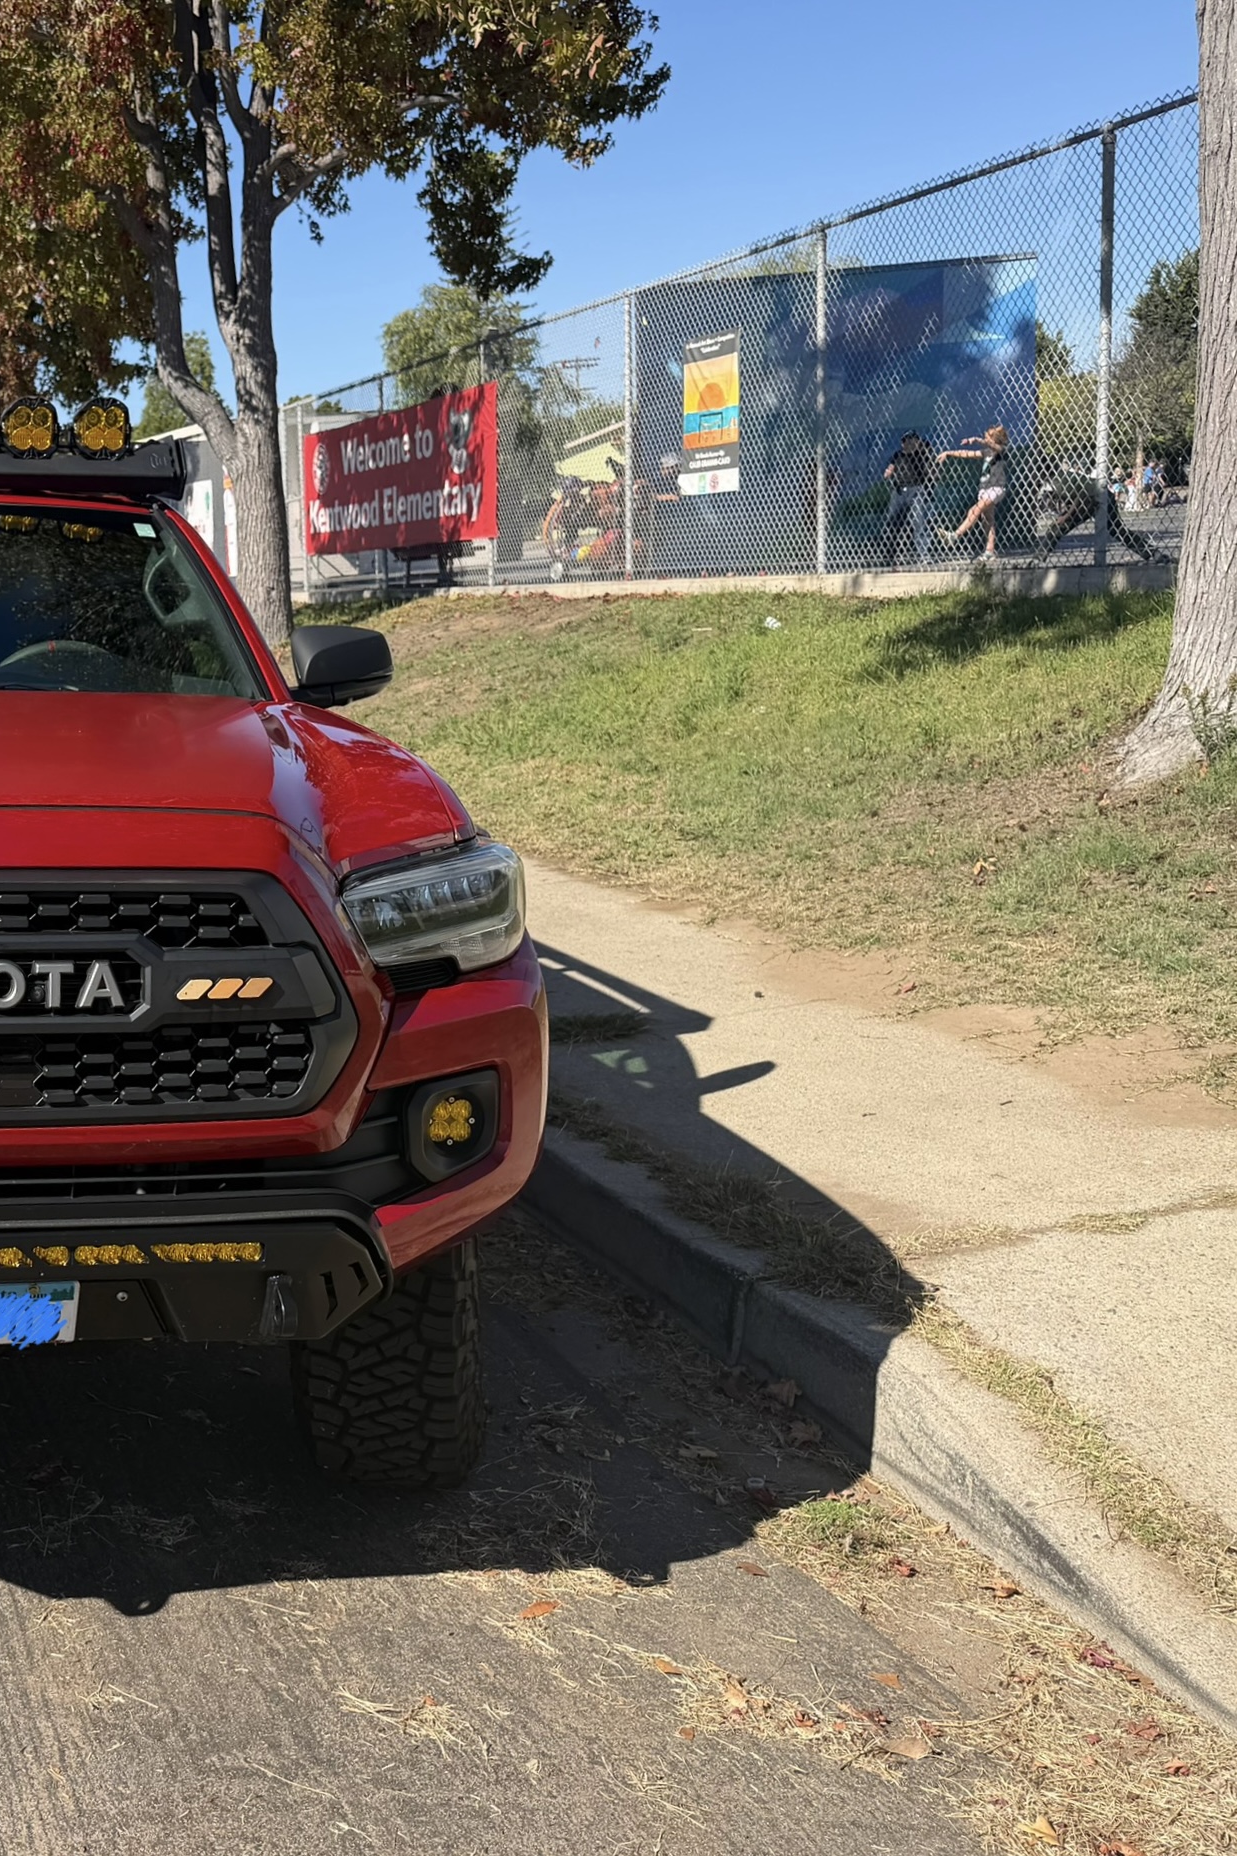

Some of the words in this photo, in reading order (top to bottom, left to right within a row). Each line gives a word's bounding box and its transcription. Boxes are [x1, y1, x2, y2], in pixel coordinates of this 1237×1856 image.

[341, 433, 410, 475] Welcome
[415, 425, 433, 460] to
[309, 490, 379, 534] Kentwood
[383, 480, 481, 522] Elementary
